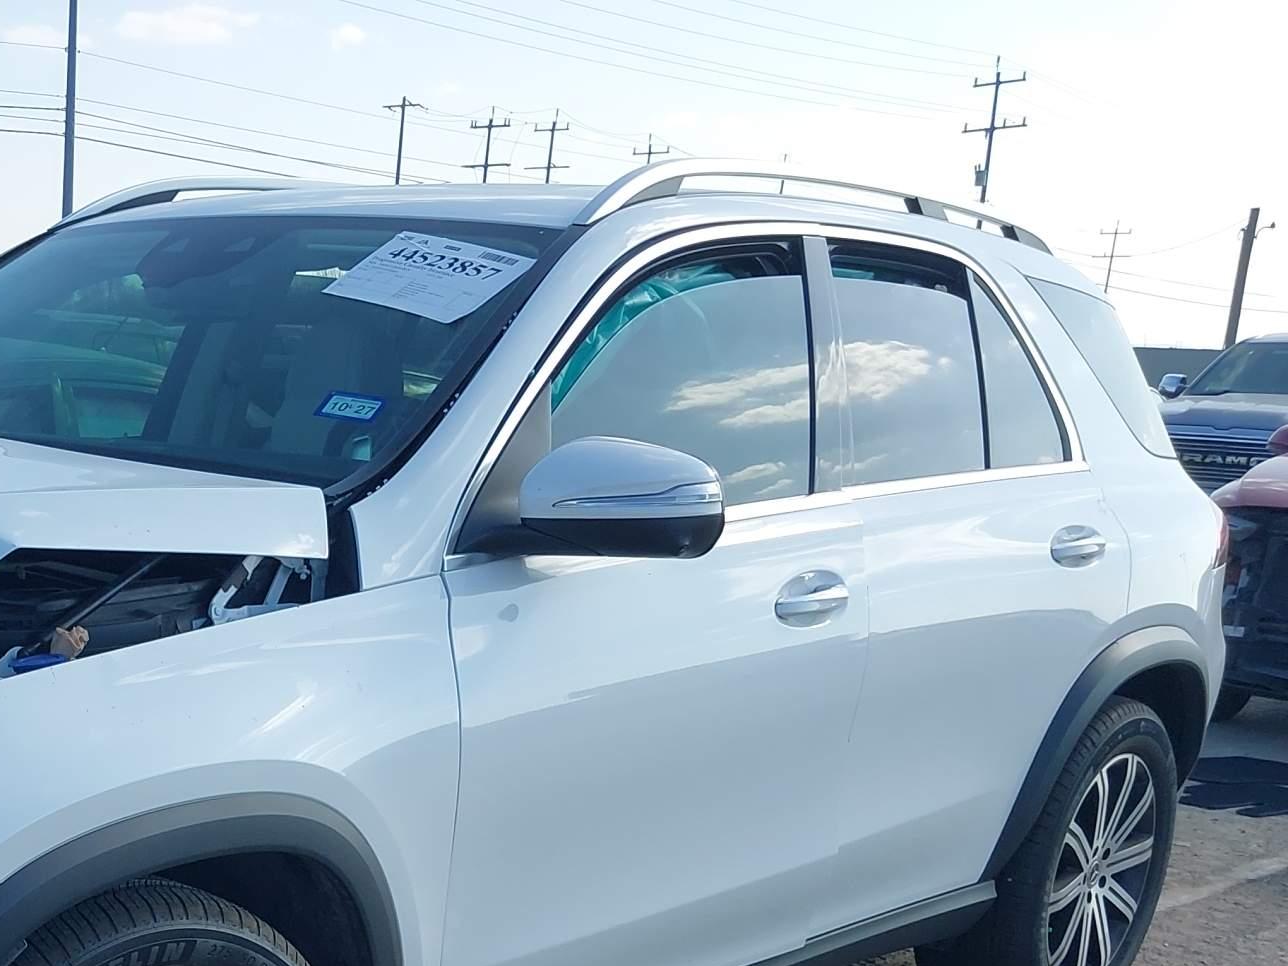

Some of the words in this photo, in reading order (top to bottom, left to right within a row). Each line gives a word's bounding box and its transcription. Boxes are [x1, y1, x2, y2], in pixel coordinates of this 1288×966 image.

[389, 246, 503, 280] 44523857
[330, 401, 349, 412] 10
[354, 404, 376, 416] 27
[1181, 452, 1249, 466] RAM
